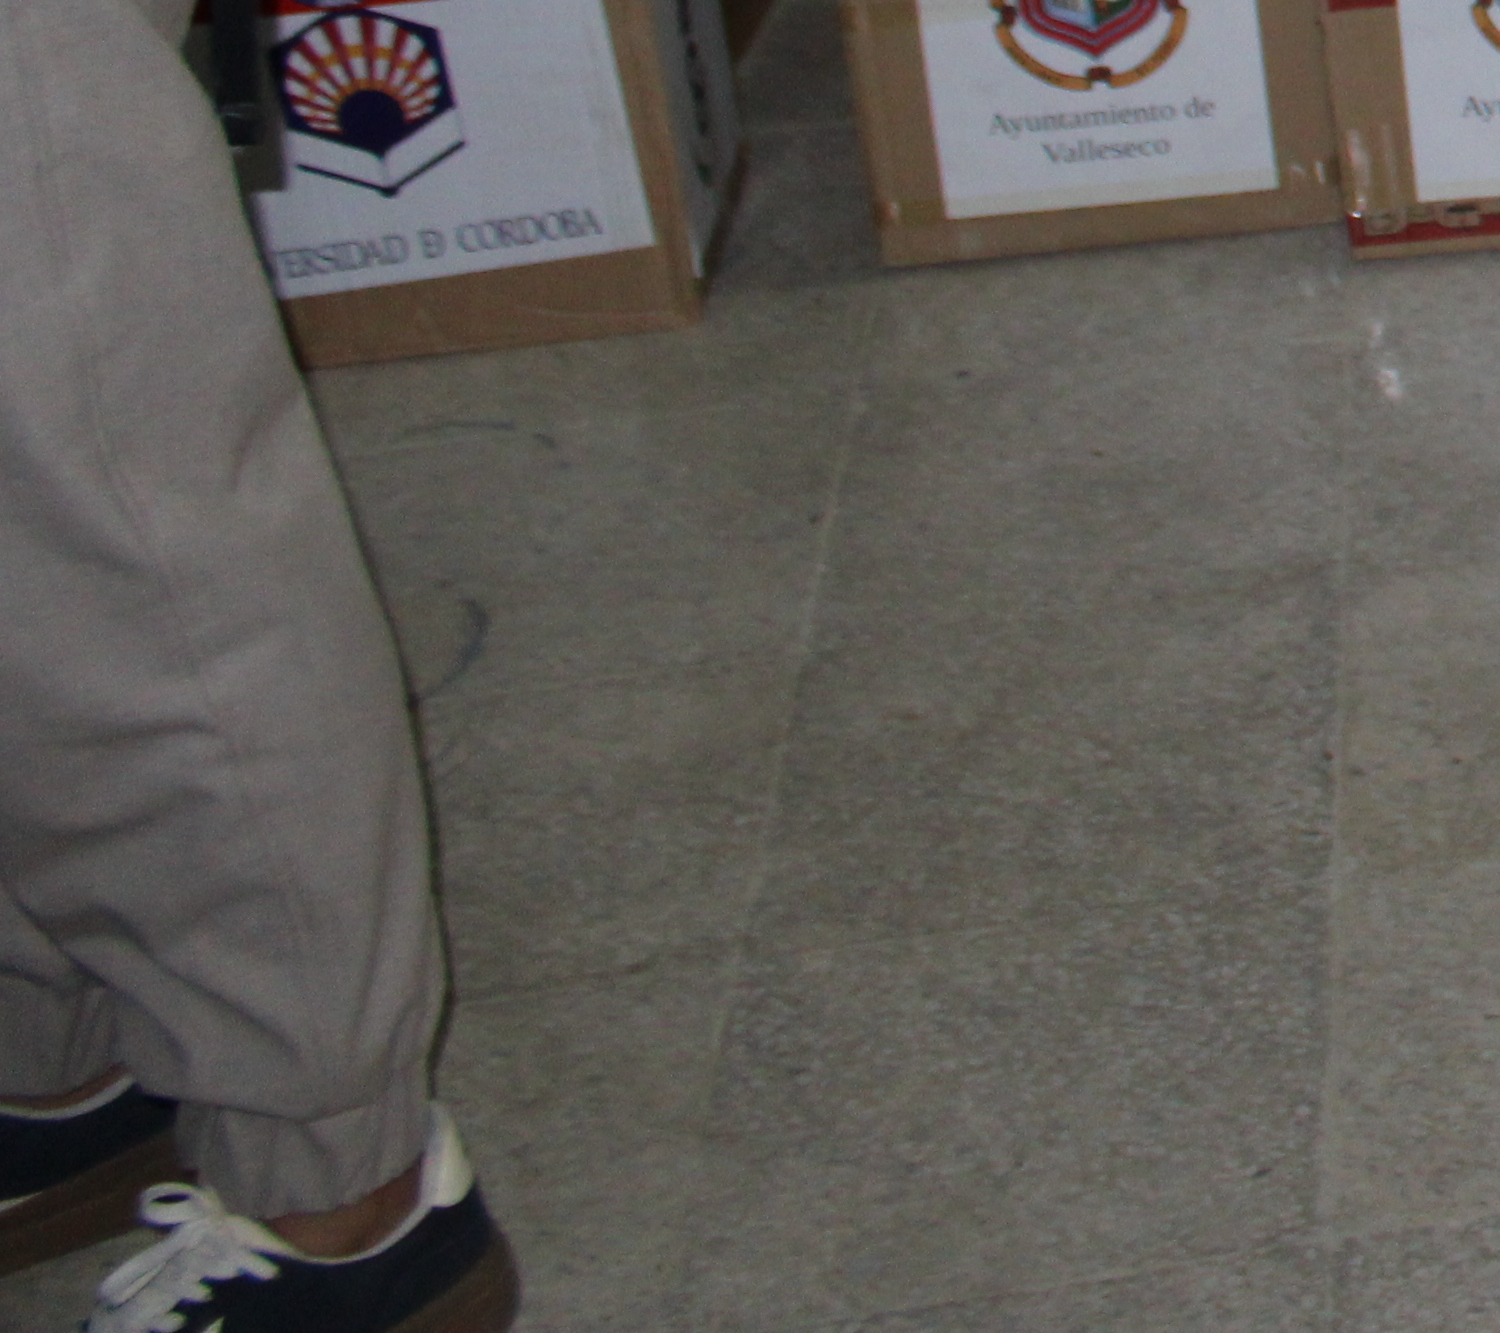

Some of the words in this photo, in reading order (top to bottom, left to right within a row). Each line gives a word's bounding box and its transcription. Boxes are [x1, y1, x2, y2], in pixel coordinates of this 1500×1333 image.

[988, 103, 1177, 141] Ayuntamiento
[1183, 95, 1217, 119] de
[1041, 138, 1171, 164] Valleseco
